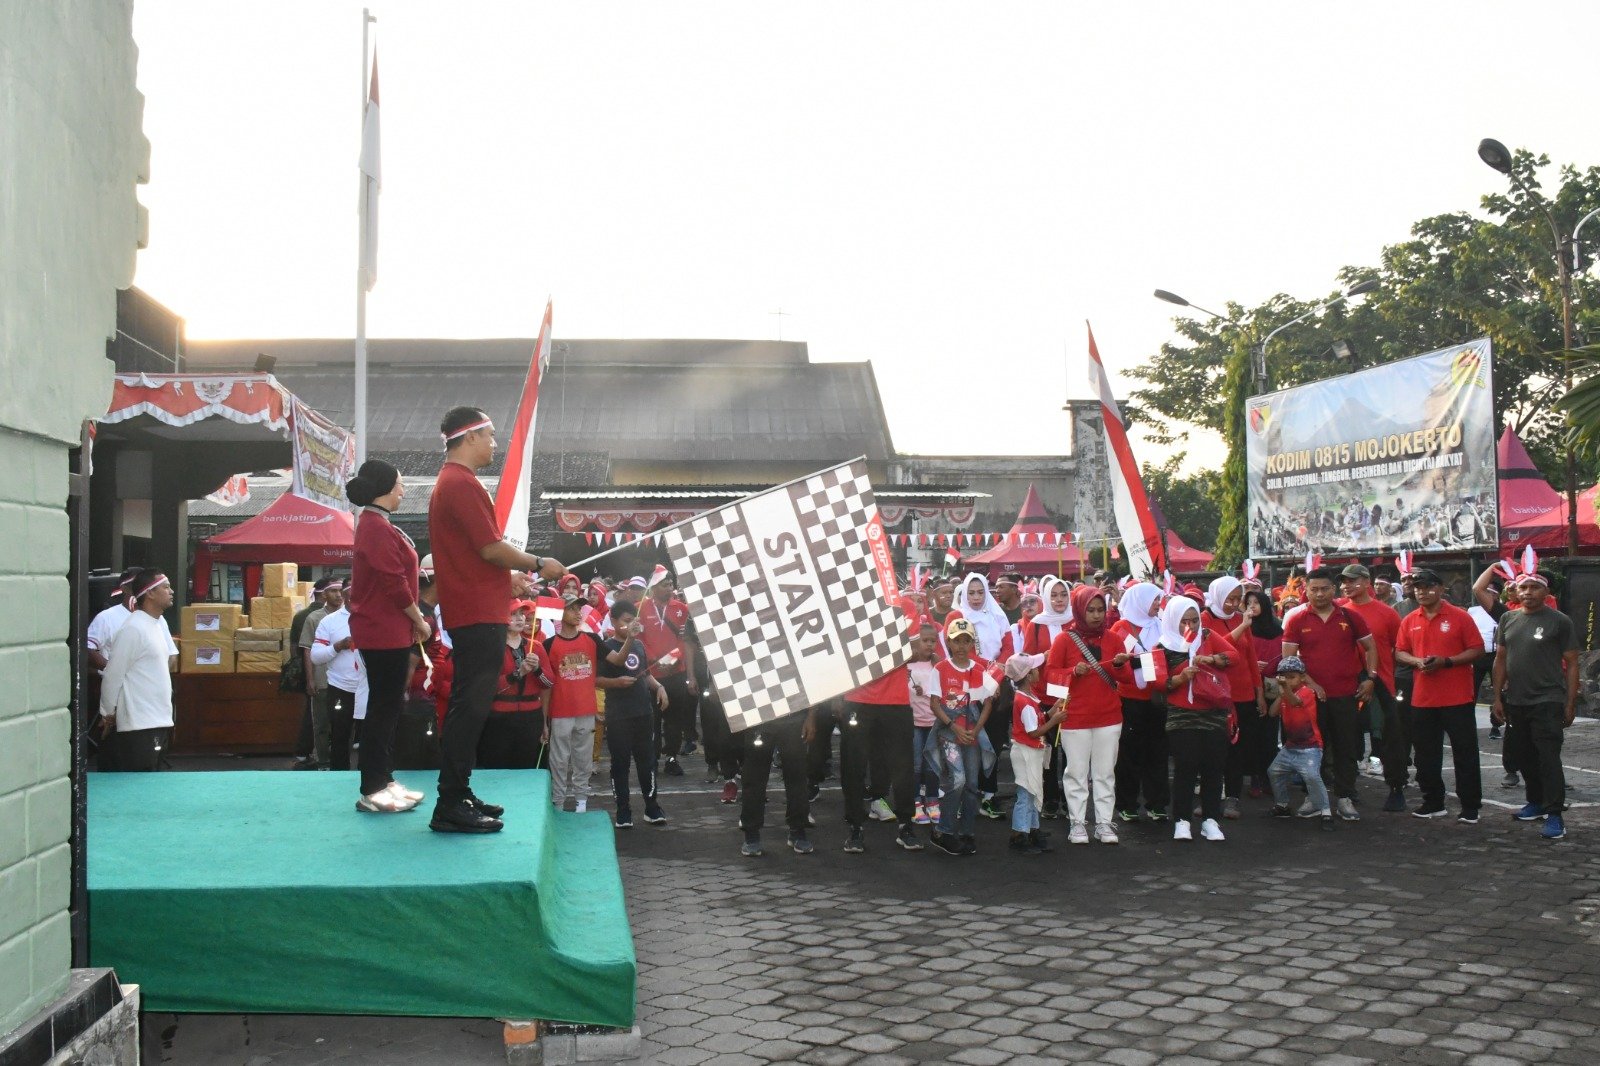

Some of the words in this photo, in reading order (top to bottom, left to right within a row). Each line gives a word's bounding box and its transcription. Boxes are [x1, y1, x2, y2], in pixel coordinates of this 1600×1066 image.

[1267, 449, 1311, 475] KODIM
[1314, 442, 1350, 468] 0815
[1354, 423, 1462, 462] MOJOKERTO
[1351, 463, 1388, 480] BERSINERGI
[1435, 452, 1463, 469] RAKYAT
[262, 514, 317, 523] bankjatim
[763, 531, 835, 658] START
[875, 540, 889, 568] TOP
[883, 569, 897, 605] SELL
